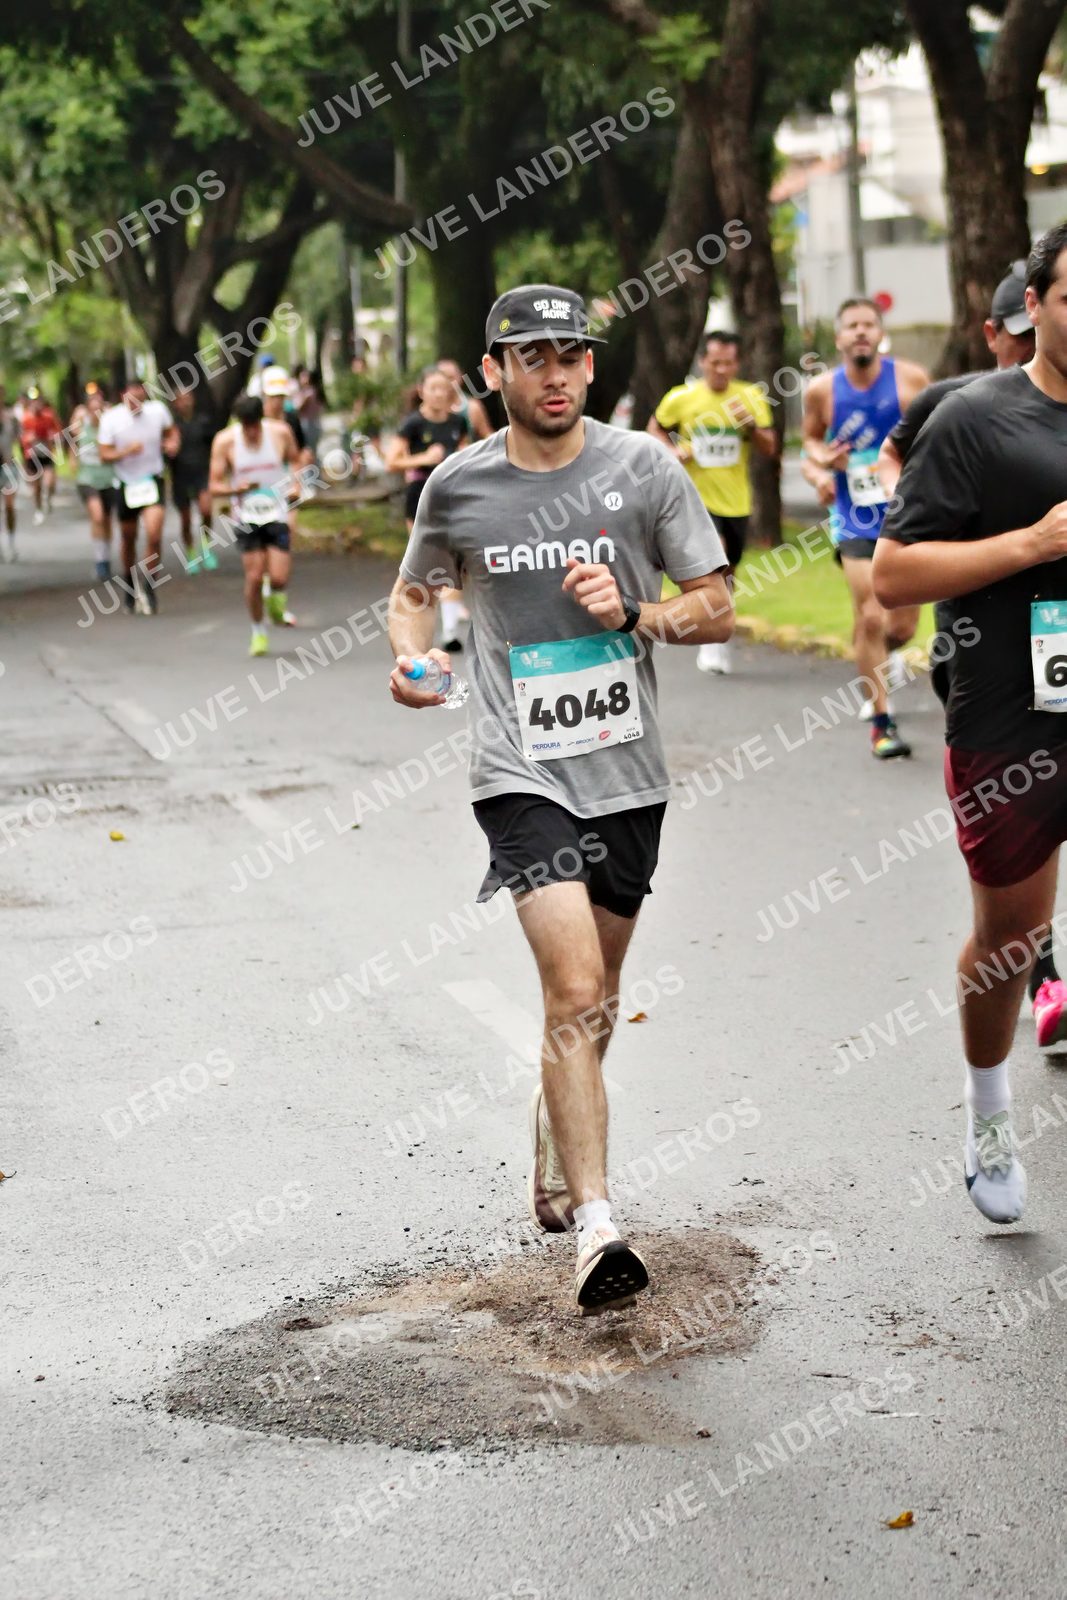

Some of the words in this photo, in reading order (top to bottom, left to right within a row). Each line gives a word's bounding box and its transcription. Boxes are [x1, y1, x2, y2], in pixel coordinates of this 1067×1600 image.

[533, 300, 550, 312] GO
[551, 300, 572, 312] ONE
[542, 310, 570, 320] MORE
[529, 682, 630, 731] 4048
[624, 731, 640, 740] 4048
[532, 742, 560, 750] PERDURA
